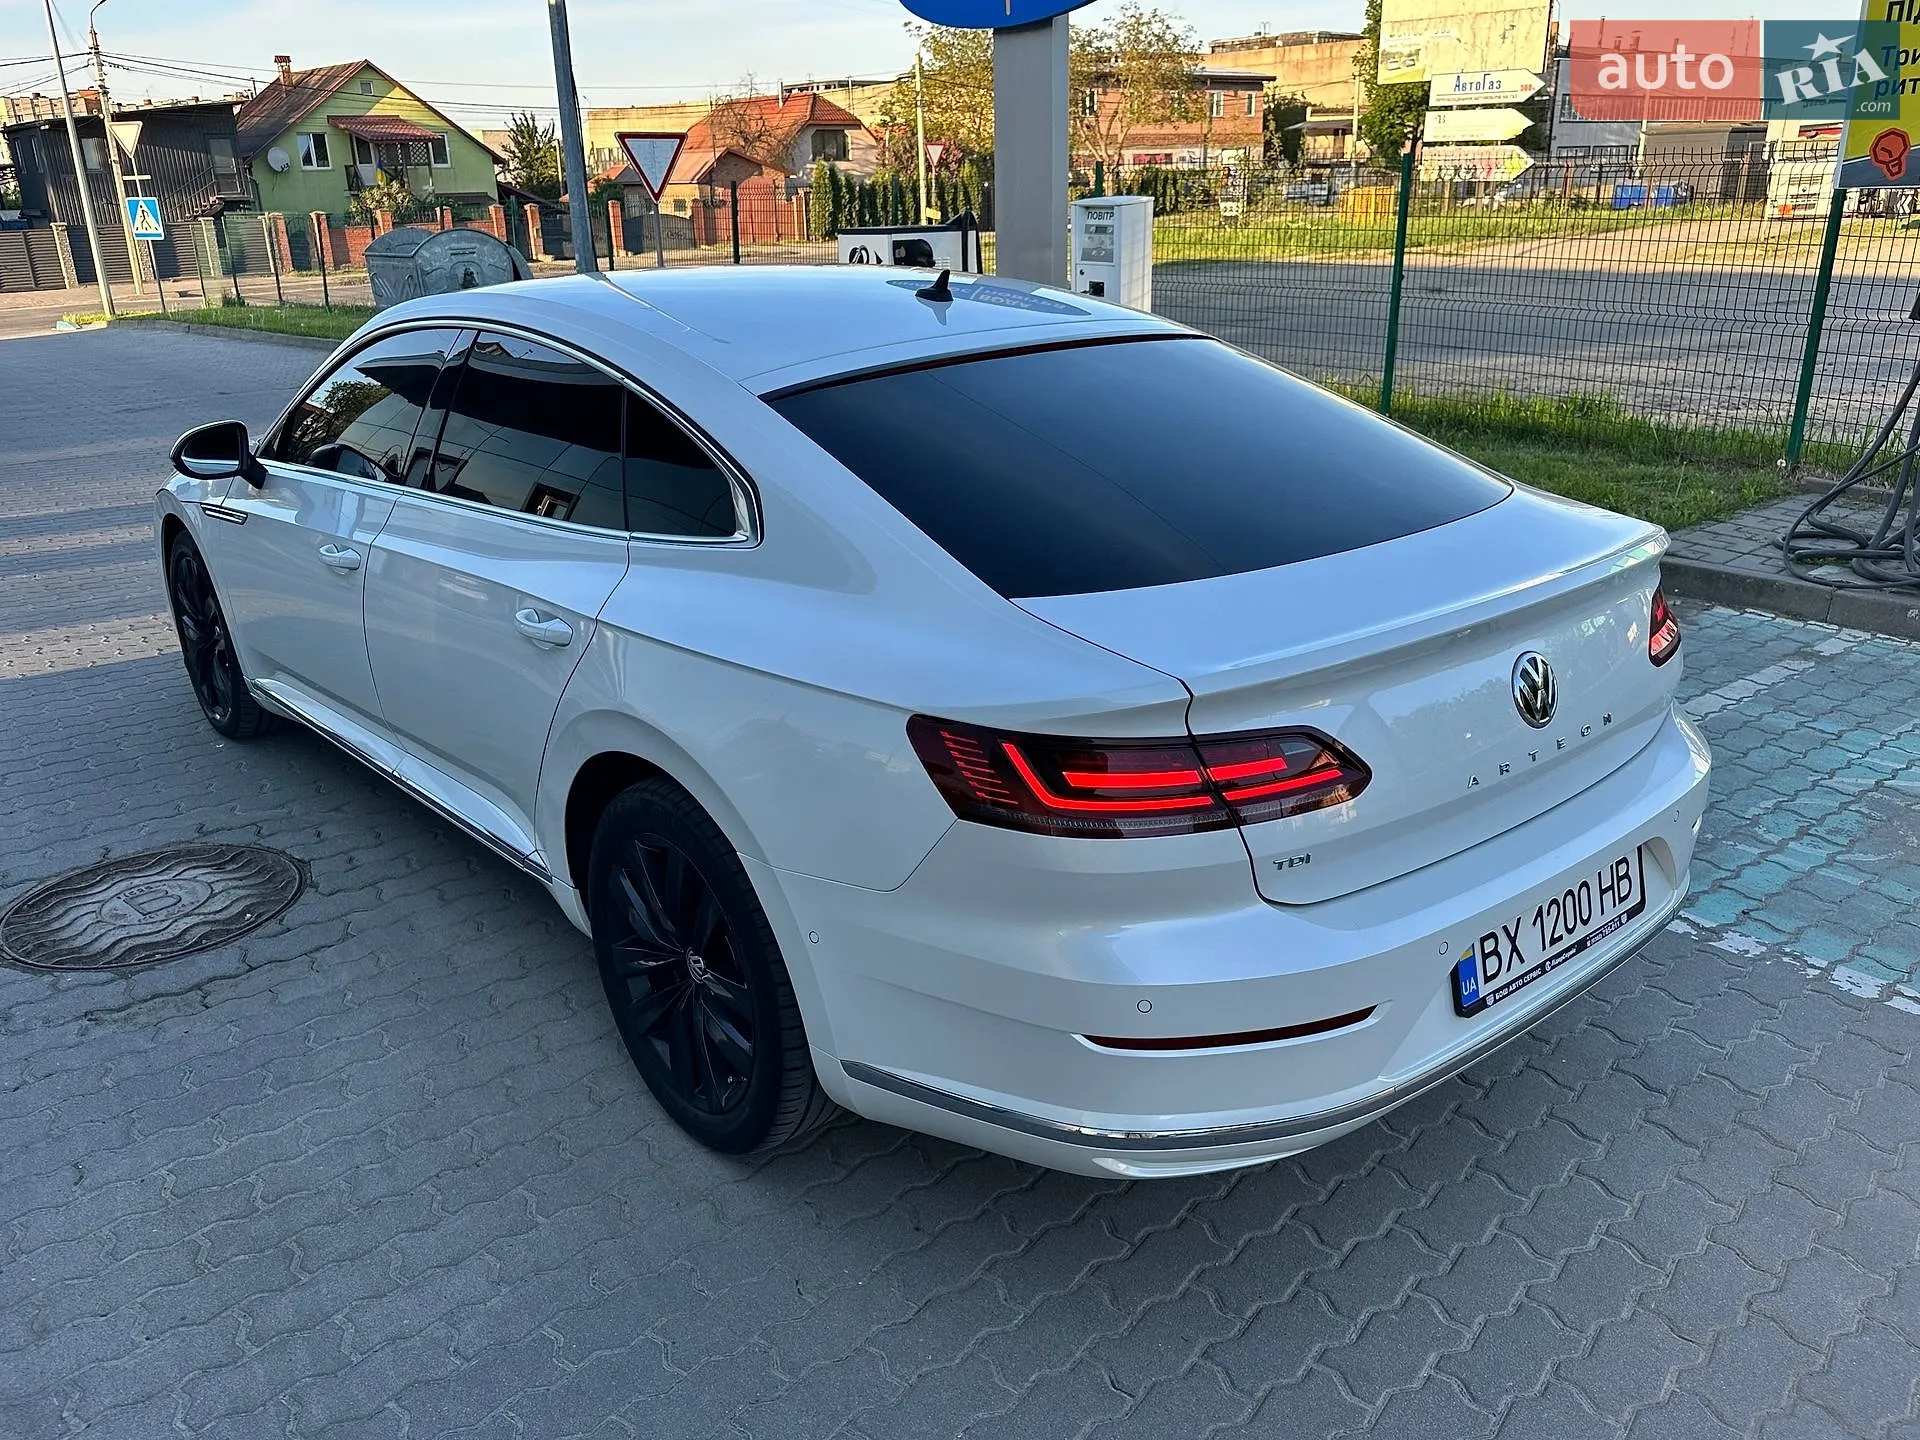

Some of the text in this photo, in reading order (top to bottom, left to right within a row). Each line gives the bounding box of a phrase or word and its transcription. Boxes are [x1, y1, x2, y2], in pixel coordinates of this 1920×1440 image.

[1467, 711, 1612, 788] ARTEON
[1273, 853, 1311, 871] TDI
[1480, 856, 1632, 985] BX 1200 HB
[1462, 977, 1477, 995] UA
[1509, 979, 1523, 992] АВТО
